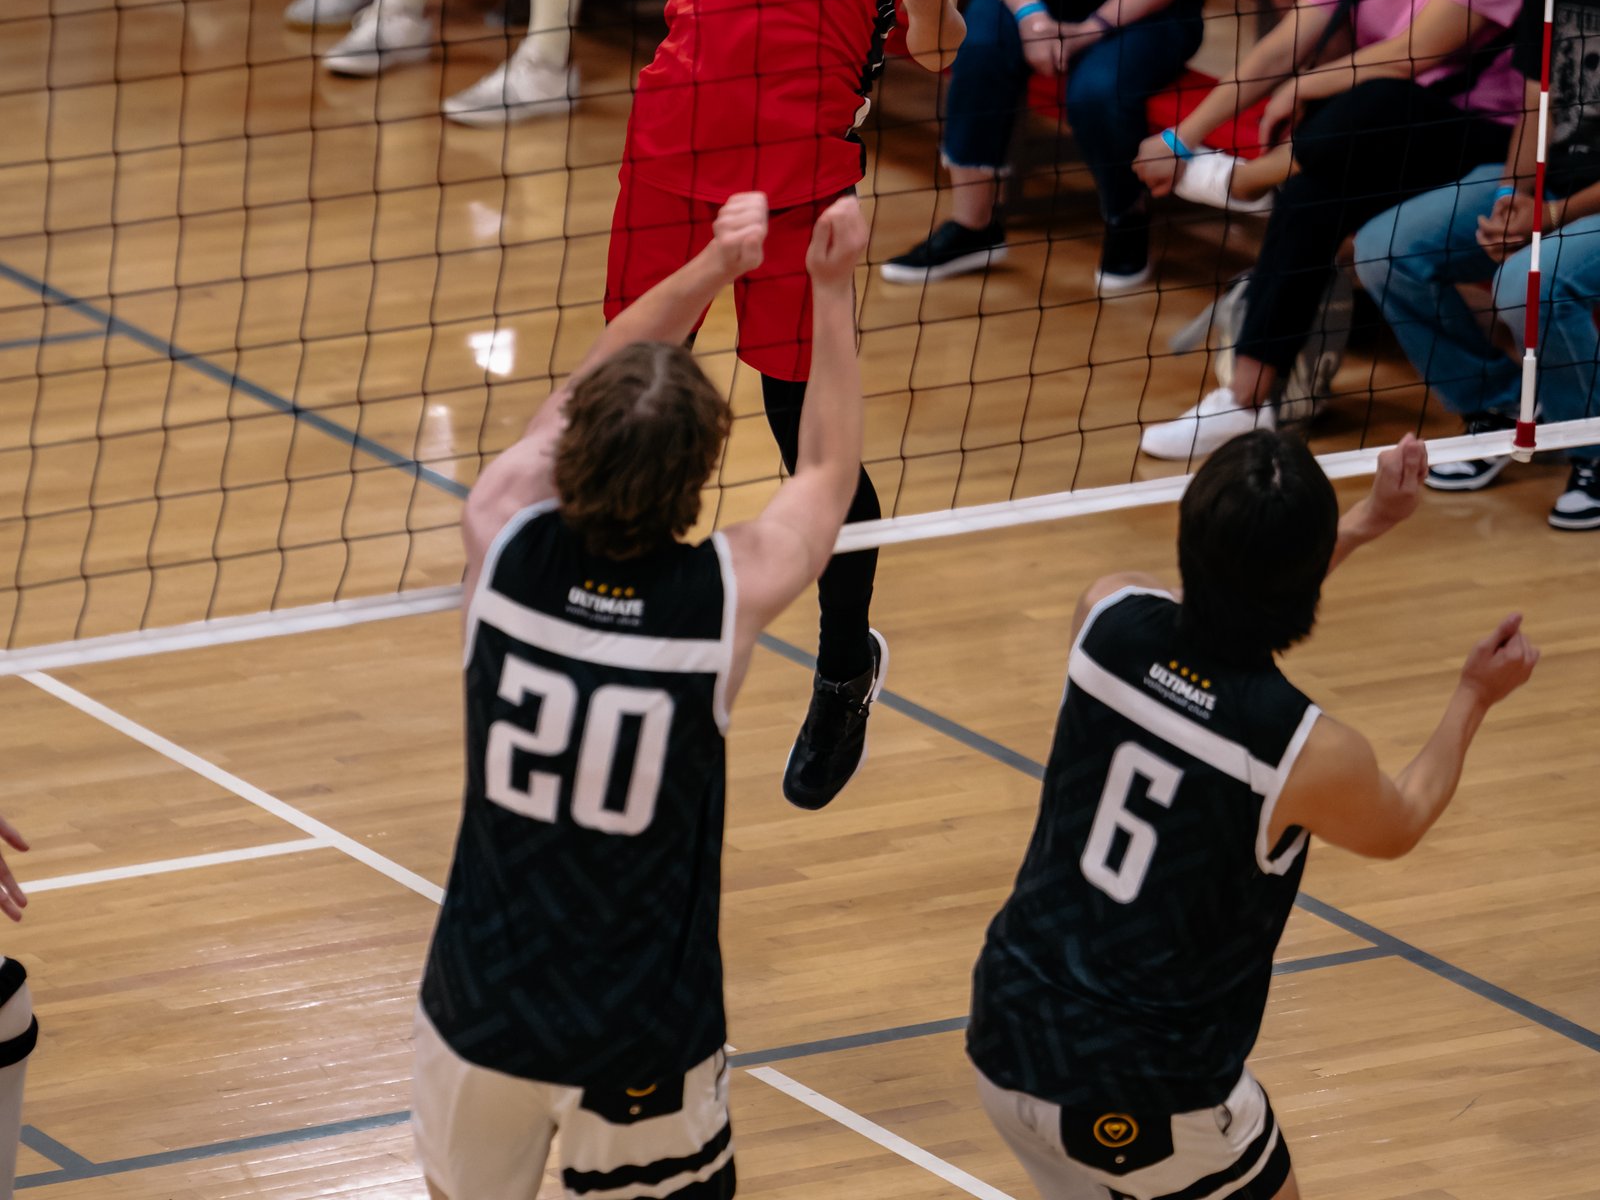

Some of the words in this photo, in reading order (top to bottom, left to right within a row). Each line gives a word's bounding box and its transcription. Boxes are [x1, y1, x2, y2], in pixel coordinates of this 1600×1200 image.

[568, 586, 644, 617] ULTIMATE
[1149, 662, 1217, 711] ULTIMATE
[484, 652, 675, 837] 20
[1080, 740, 1185, 905] 6
